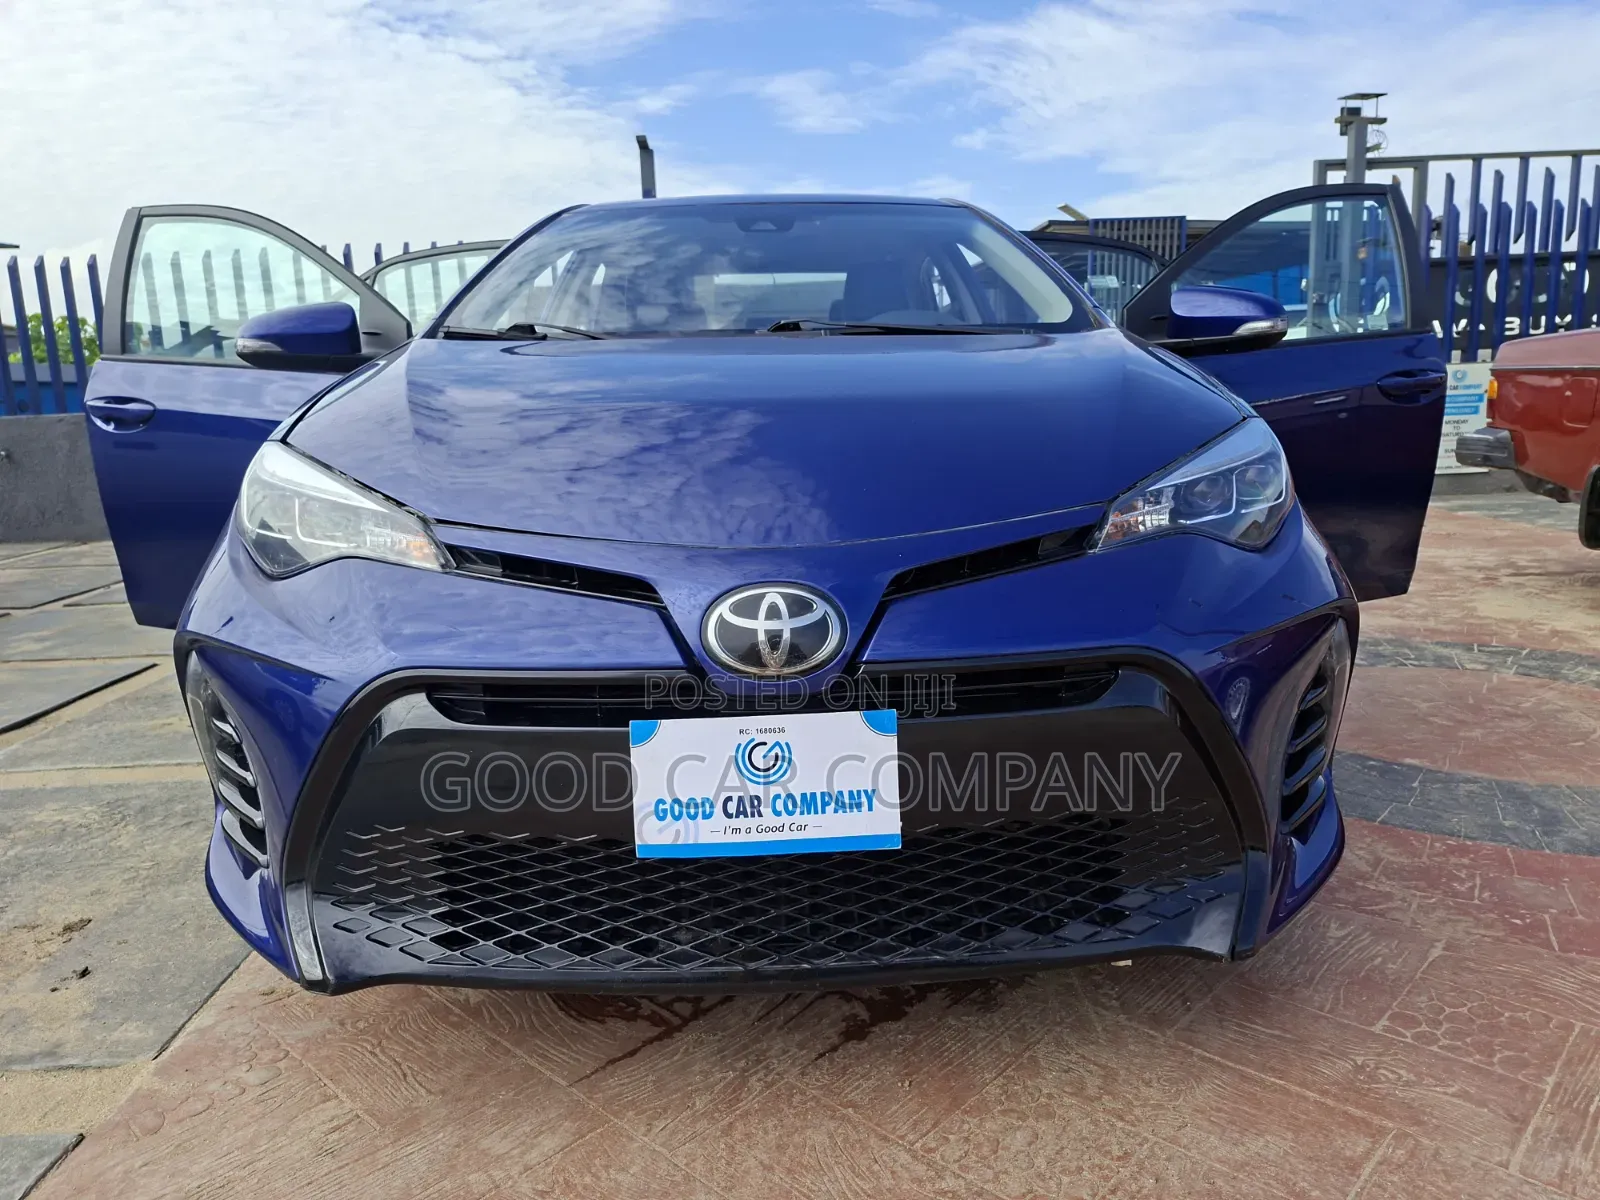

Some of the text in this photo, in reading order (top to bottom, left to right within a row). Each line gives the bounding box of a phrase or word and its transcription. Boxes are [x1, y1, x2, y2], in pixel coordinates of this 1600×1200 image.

[755, 726, 786, 735] 1680636
[654, 788, 877, 822] GOOD CAR COMPANY
[723, 825, 742, 835] I'm
[755, 823, 785, 834] Good
[789, 822, 809, 832] Car
